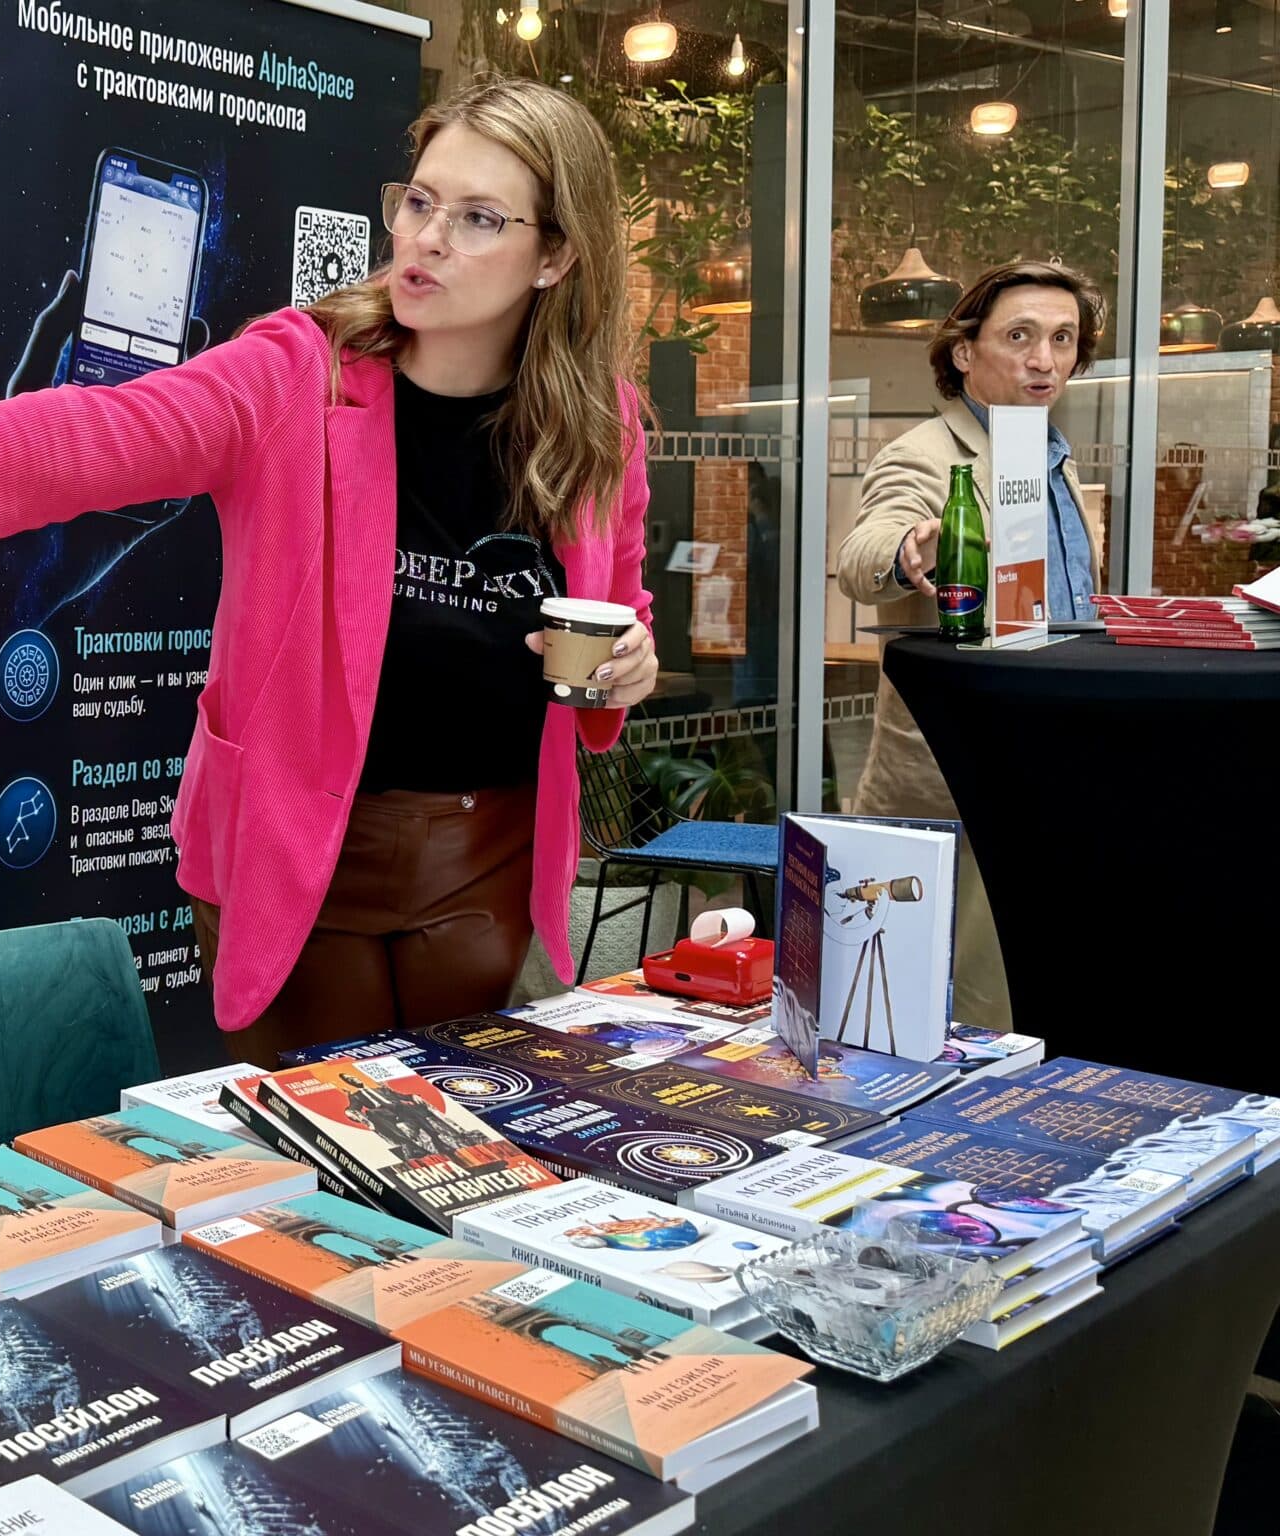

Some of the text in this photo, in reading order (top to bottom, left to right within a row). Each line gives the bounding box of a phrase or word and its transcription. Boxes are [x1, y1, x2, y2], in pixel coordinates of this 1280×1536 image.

[18, 1, 355, 101] Мобильное приложение AlphaSpace
[76, 62, 307, 133] с трактовками гороскопа
[998, 474, 1041, 506] ÜBERBAU
[74, 626, 163, 660] Трактовки
[73, 672, 104, 694] Один
[109, 674, 136, 690] клик
[157, 673, 164, 687] и
[168, 672, 182, 687] вы
[73, 694, 147, 719] вашу судьбу.
[72, 757, 185, 789] Раздел со зв
[71, 805, 80, 824] В
[82, 803, 129, 827] разделе
[132, 798, 158, 819] Deep
[70, 823, 172, 849] и опасные звезд
[70, 847, 173, 878] Трактовки покажут,
[159, 909, 169, 930] с
[148, 945, 189, 967] планету
[165, 963, 202, 989] судьбу
[572, 1120, 622, 1140] ЗАНОВО
[277, 1137, 300, 1161] КНИГА
[316, 1134, 384, 1197] КНИГА ПРАВИТЕЛЕЙ
[396, 1160, 471, 1190] КНИГА
[735, 1153, 841, 1198] АСТРОЛОГИЯ
[418, 1160, 550, 1209] ПРАВИТЕЛЕЙ
[491, 1202, 543, 1220] КНИГА
[512, 1189, 627, 1229] ПРАВИТЕЛЕЙ
[715, 1203, 798, 1233] Татьяна Калинина
[511, 1245, 603, 1289] КНИГА ПРАВИТЕЛЕЙ
[190, 1318, 339, 1387] ПОСЕЙДОН
[409, 1350, 543, 1421] МЫ УЕЗЖАЛИ НАВСЕГДА...
[637, 1390, 665, 1407] МЫ
[665, 1357, 725, 1399] УЕЗЖАЛИ
[657, 1367, 738, 1412] НАВСЕГДА...
[51, 1415, 163, 1467] ПОВЕСТИ И РАССКАЗЫ
[129, 1478, 178, 1502] ТАТЬЯНА
